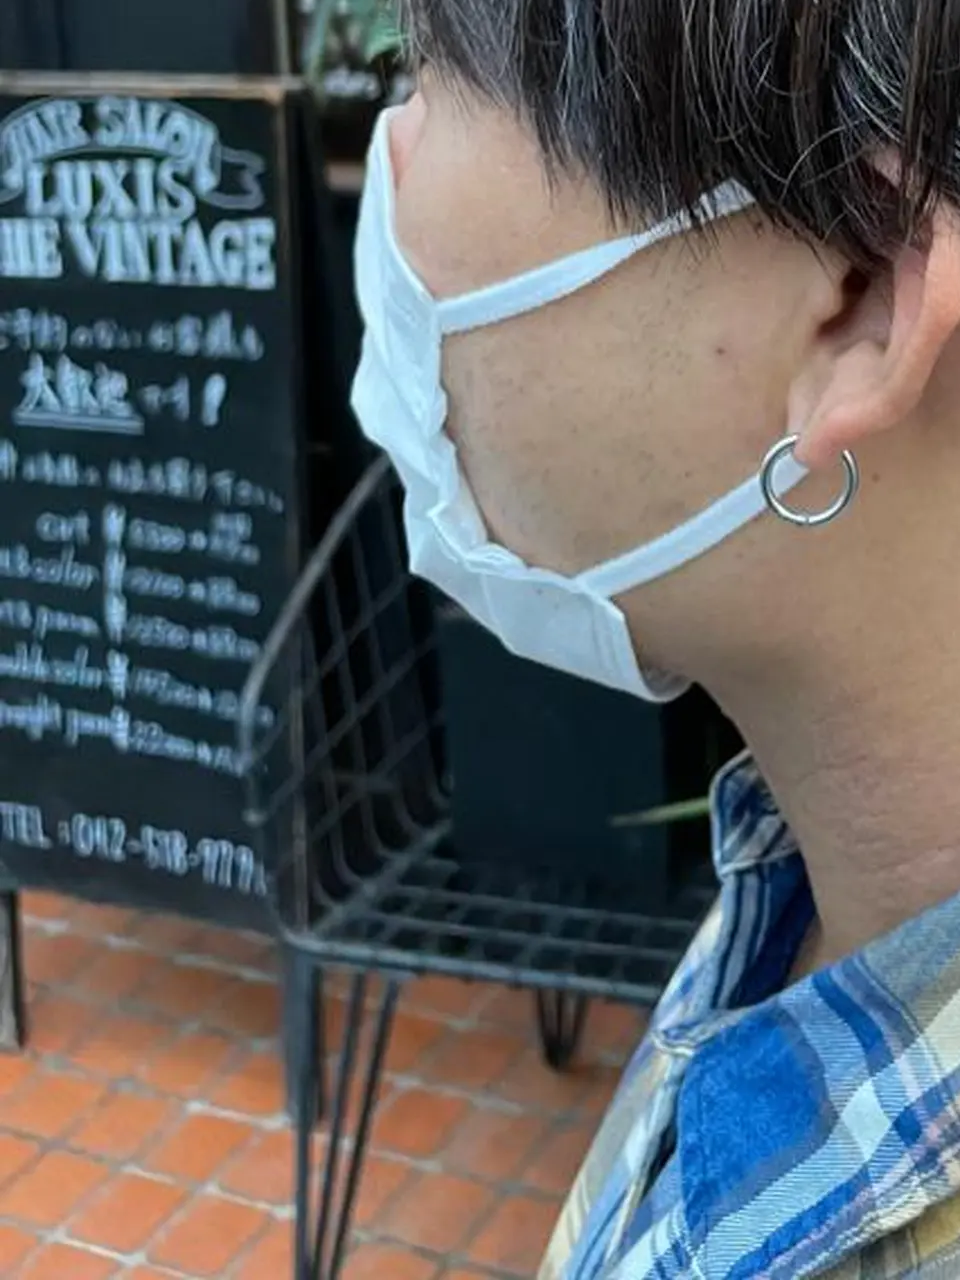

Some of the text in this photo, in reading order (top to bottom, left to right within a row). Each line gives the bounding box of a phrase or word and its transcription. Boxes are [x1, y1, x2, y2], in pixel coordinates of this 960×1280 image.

[96, 95, 219, 194] SALON
[25, 157, 195, 221] LUXIS
[66, 217, 276, 289] VINTAGE
